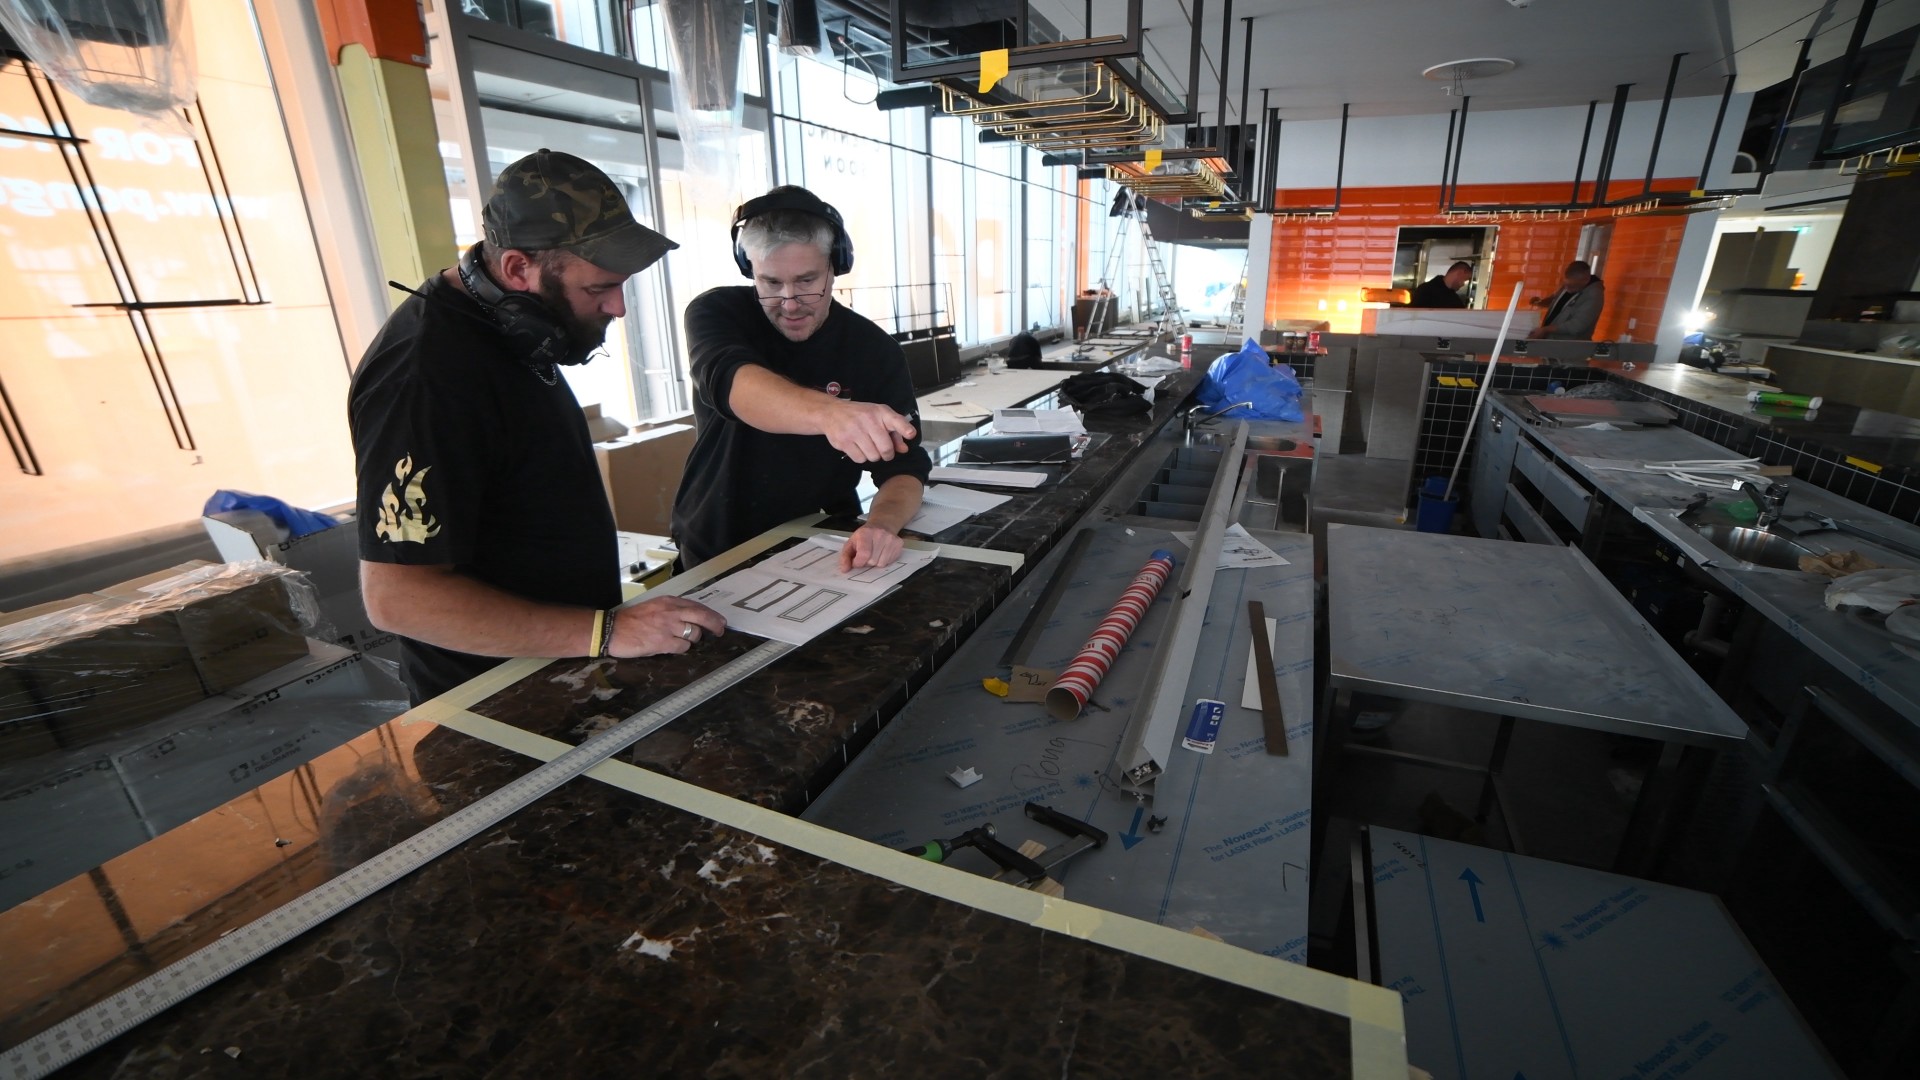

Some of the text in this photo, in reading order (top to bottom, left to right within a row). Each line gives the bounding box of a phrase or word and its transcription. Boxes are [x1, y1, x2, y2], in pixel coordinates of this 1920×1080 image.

[1203, 844, 1223, 854] The
[1210, 854, 1225, 863] for
[1224, 843, 1255, 858] LASER
[1251, 834, 1275, 847] Fiber
[1279, 821, 1306, 836] LASER
